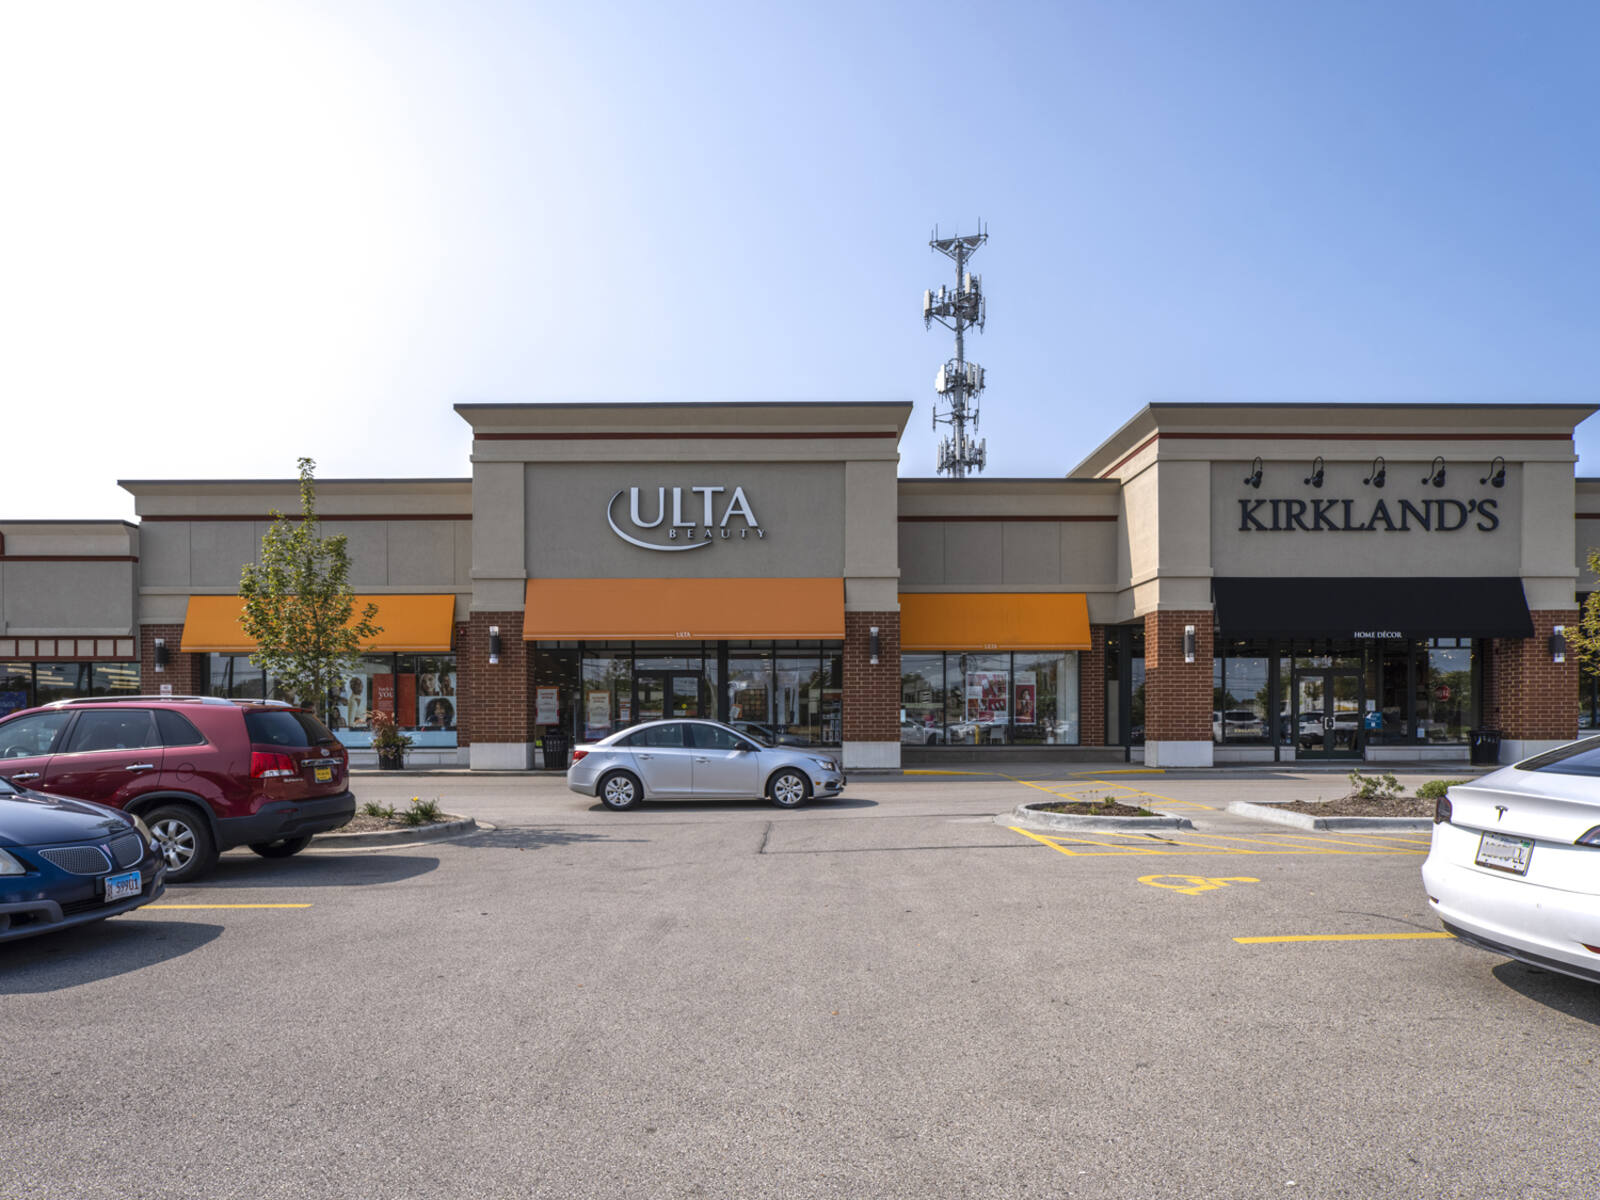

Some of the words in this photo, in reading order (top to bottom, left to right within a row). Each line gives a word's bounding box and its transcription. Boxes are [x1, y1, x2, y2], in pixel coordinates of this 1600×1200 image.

[630, 486, 758, 528] ULTA
[1238, 499, 1500, 532] KIRKLAND'S
[669, 528, 767, 540] BEAUTY
[1354, 631, 1375, 639] HOME
